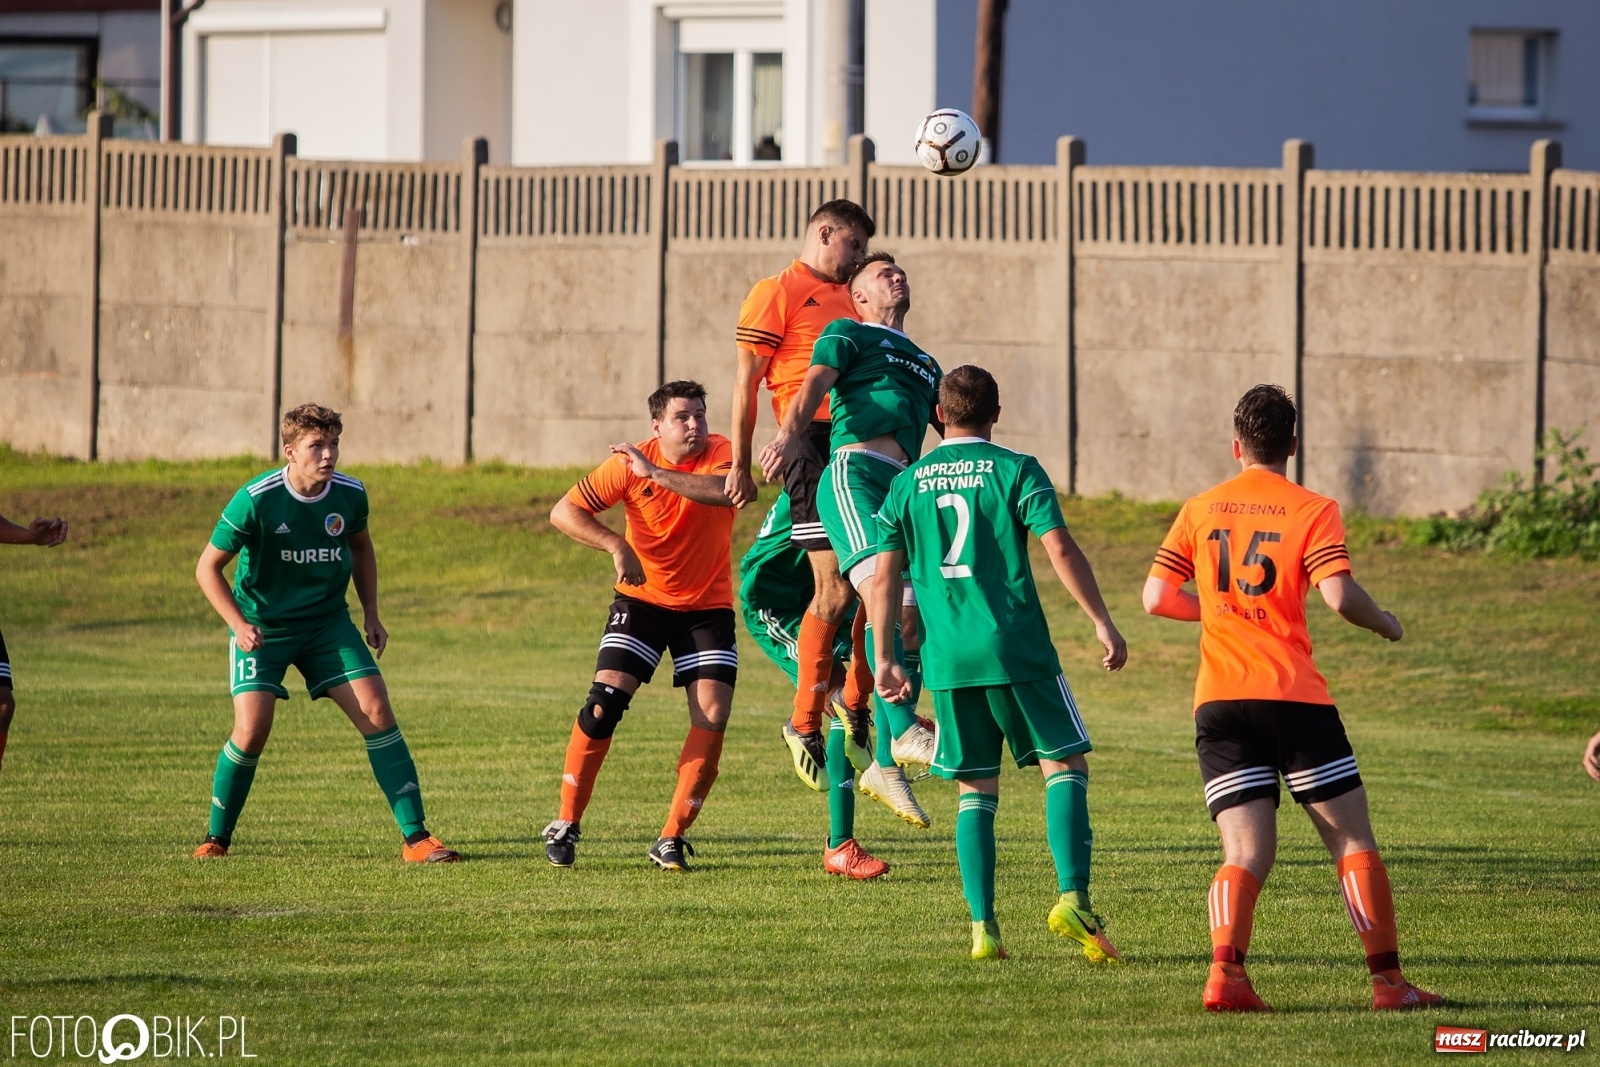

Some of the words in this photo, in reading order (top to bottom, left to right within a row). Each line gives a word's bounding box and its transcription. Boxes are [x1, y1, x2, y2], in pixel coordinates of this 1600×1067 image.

[914, 459, 974, 480] NAPRZÓD
[975, 460, 994, 473] 32
[918, 474, 985, 493] SYRYNIA
[1208, 502, 1287, 517] STUDZIENNA
[935, 493, 973, 579] 2
[280, 546, 342, 564] BUREK
[1207, 528, 1282, 597] 15
[610, 612, 628, 626] 21
[237, 656, 257, 682] 13
